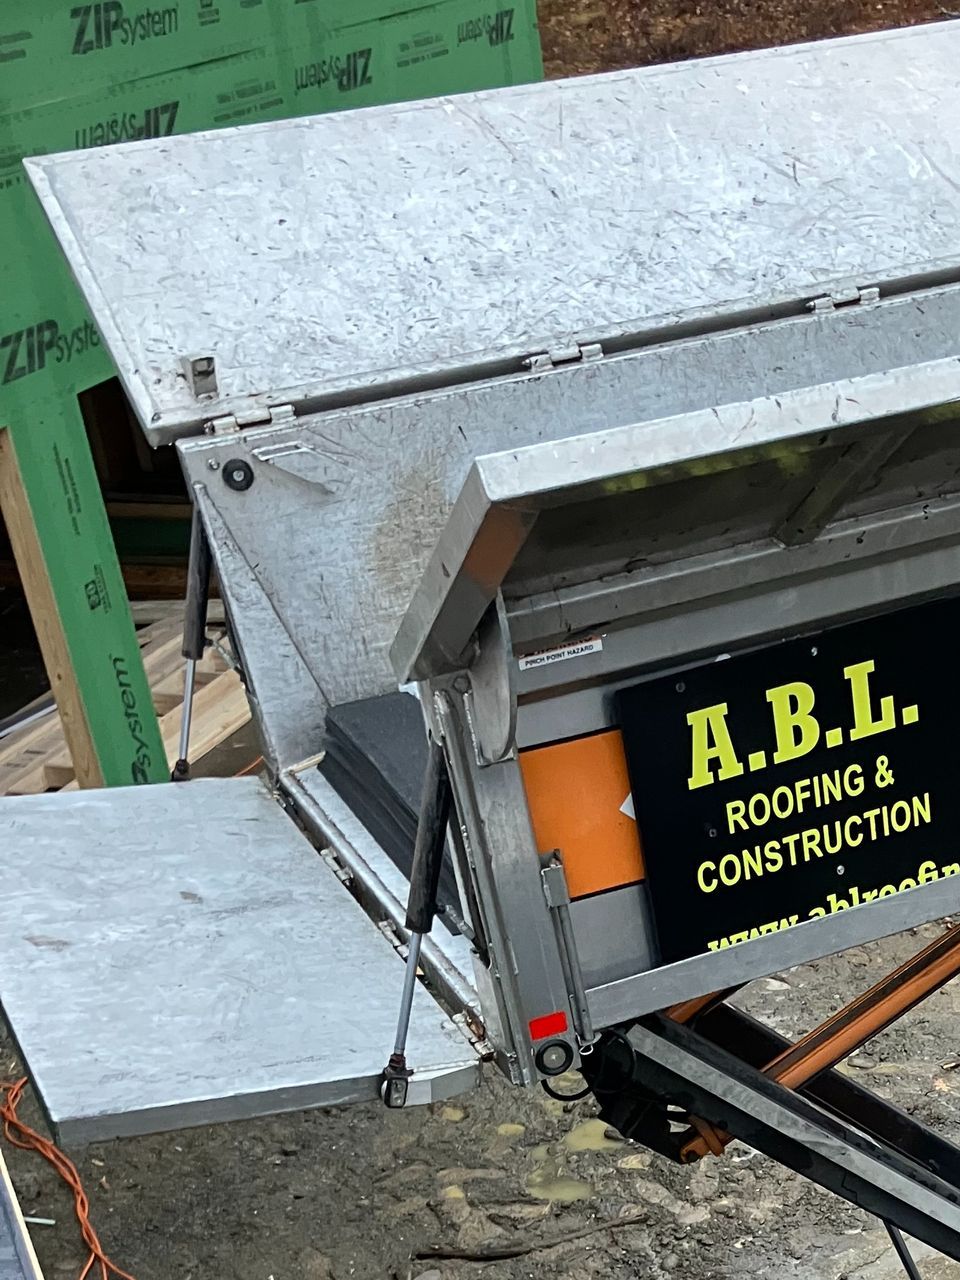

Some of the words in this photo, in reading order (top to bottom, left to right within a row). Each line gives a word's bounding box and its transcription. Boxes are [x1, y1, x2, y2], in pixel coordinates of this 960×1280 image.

[686, 659, 919, 790] A.B.L.
[697, 792, 932, 893] CONSTRUCTION
[726, 763, 865, 834] ROOFING
[875, 755, 895, 788] &
